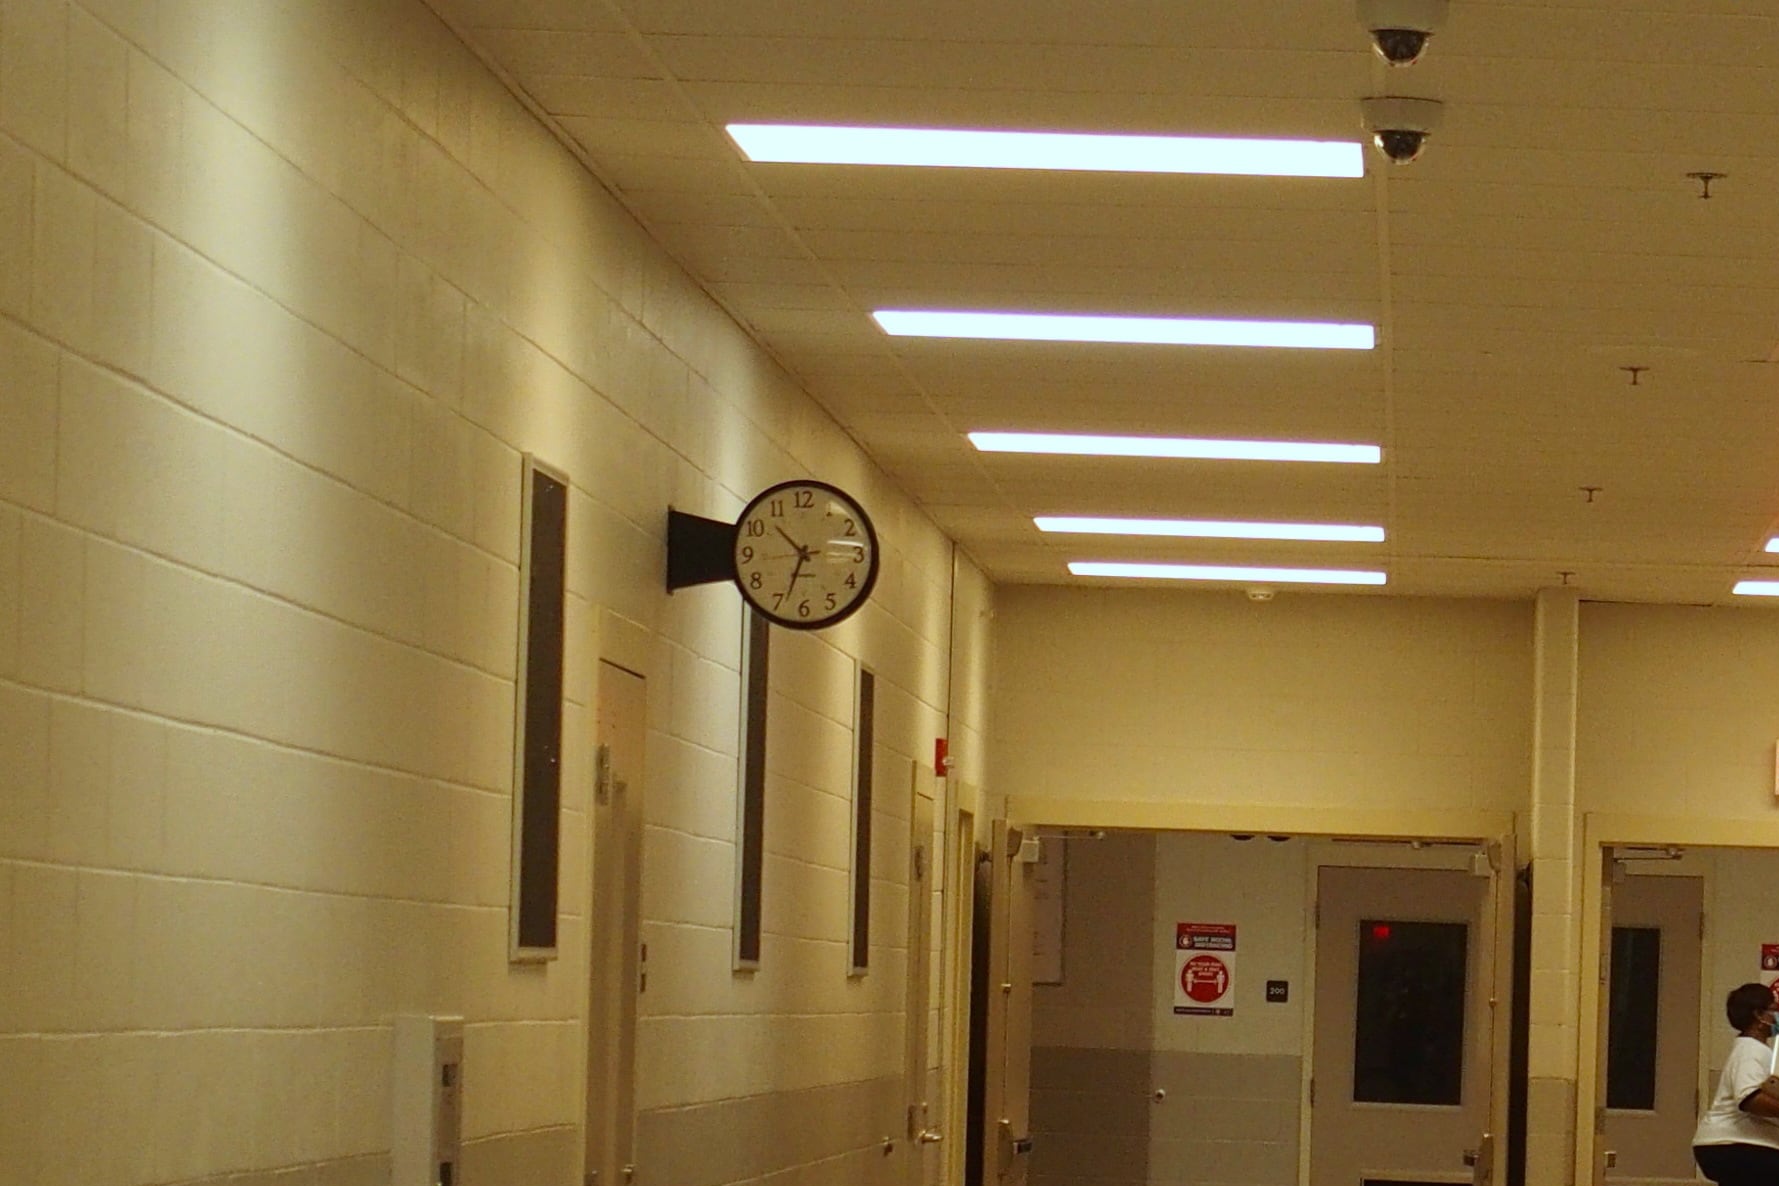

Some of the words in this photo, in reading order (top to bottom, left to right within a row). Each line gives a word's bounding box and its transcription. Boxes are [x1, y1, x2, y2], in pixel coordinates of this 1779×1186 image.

[794, 491, 814, 508] 12
[770, 500, 784, 517] 11
[746, 519, 764, 537] 10
[844, 519, 856, 536] 2
[742, 546, 754, 564] 9
[853, 546, 865, 564] 3
[750, 572, 762, 590] 8
[844, 572, 856, 589] 4
[772, 594, 783, 611] 7
[798, 600, 810, 617] 6
[826, 593, 836, 610] 5
